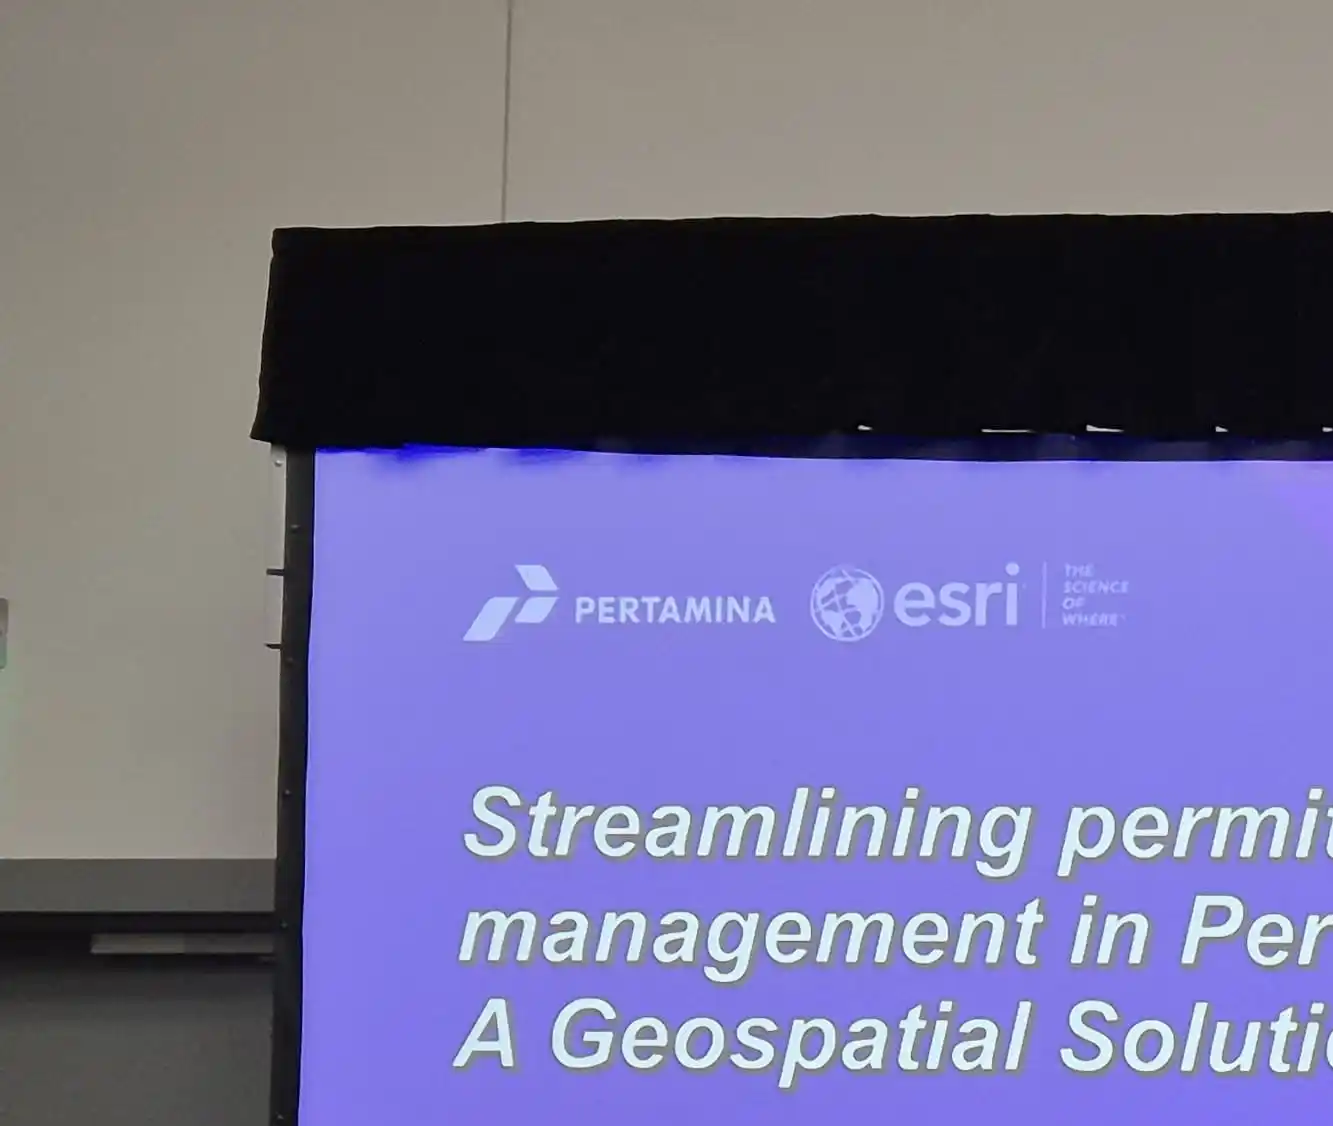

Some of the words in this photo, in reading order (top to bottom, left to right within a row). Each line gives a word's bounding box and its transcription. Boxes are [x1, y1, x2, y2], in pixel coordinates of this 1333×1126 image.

[575, 595, 776, 624] PERTAMINA
[894, 562, 1019, 626] esri
[1062, 597, 1085, 610] OF
[1063, 580, 1128, 594] SCIENCE
[463, 785, 1033, 878] Streamlining
[458, 897, 1044, 983] management
[1070, 894, 1150, 965] in
[453, 998, 515, 1068] A
[551, 998, 1032, 1089] Geospatial
